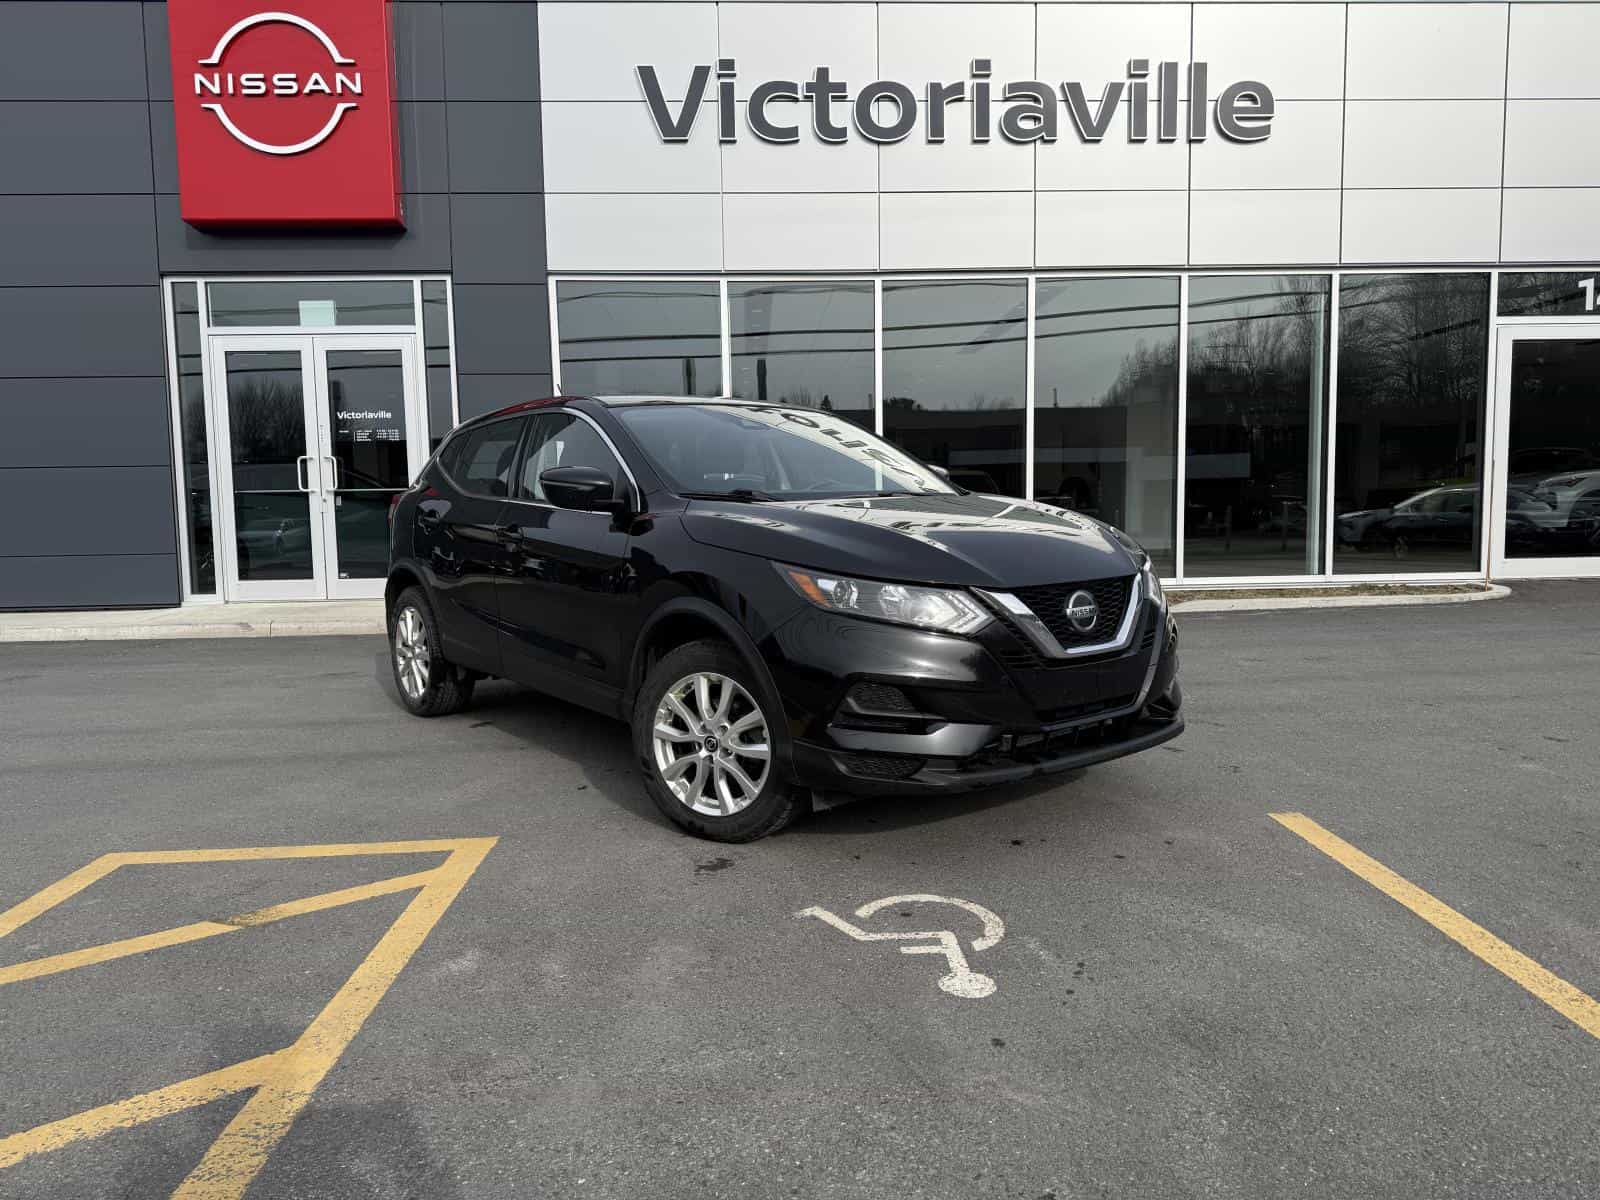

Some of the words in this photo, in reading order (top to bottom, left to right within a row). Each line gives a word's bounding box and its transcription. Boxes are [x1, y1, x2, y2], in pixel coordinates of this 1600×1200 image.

[194, 73, 362, 95] NISSAN
[636, 59, 1274, 142] Victoriaville
[336, 410, 392, 419] Victoriaville
